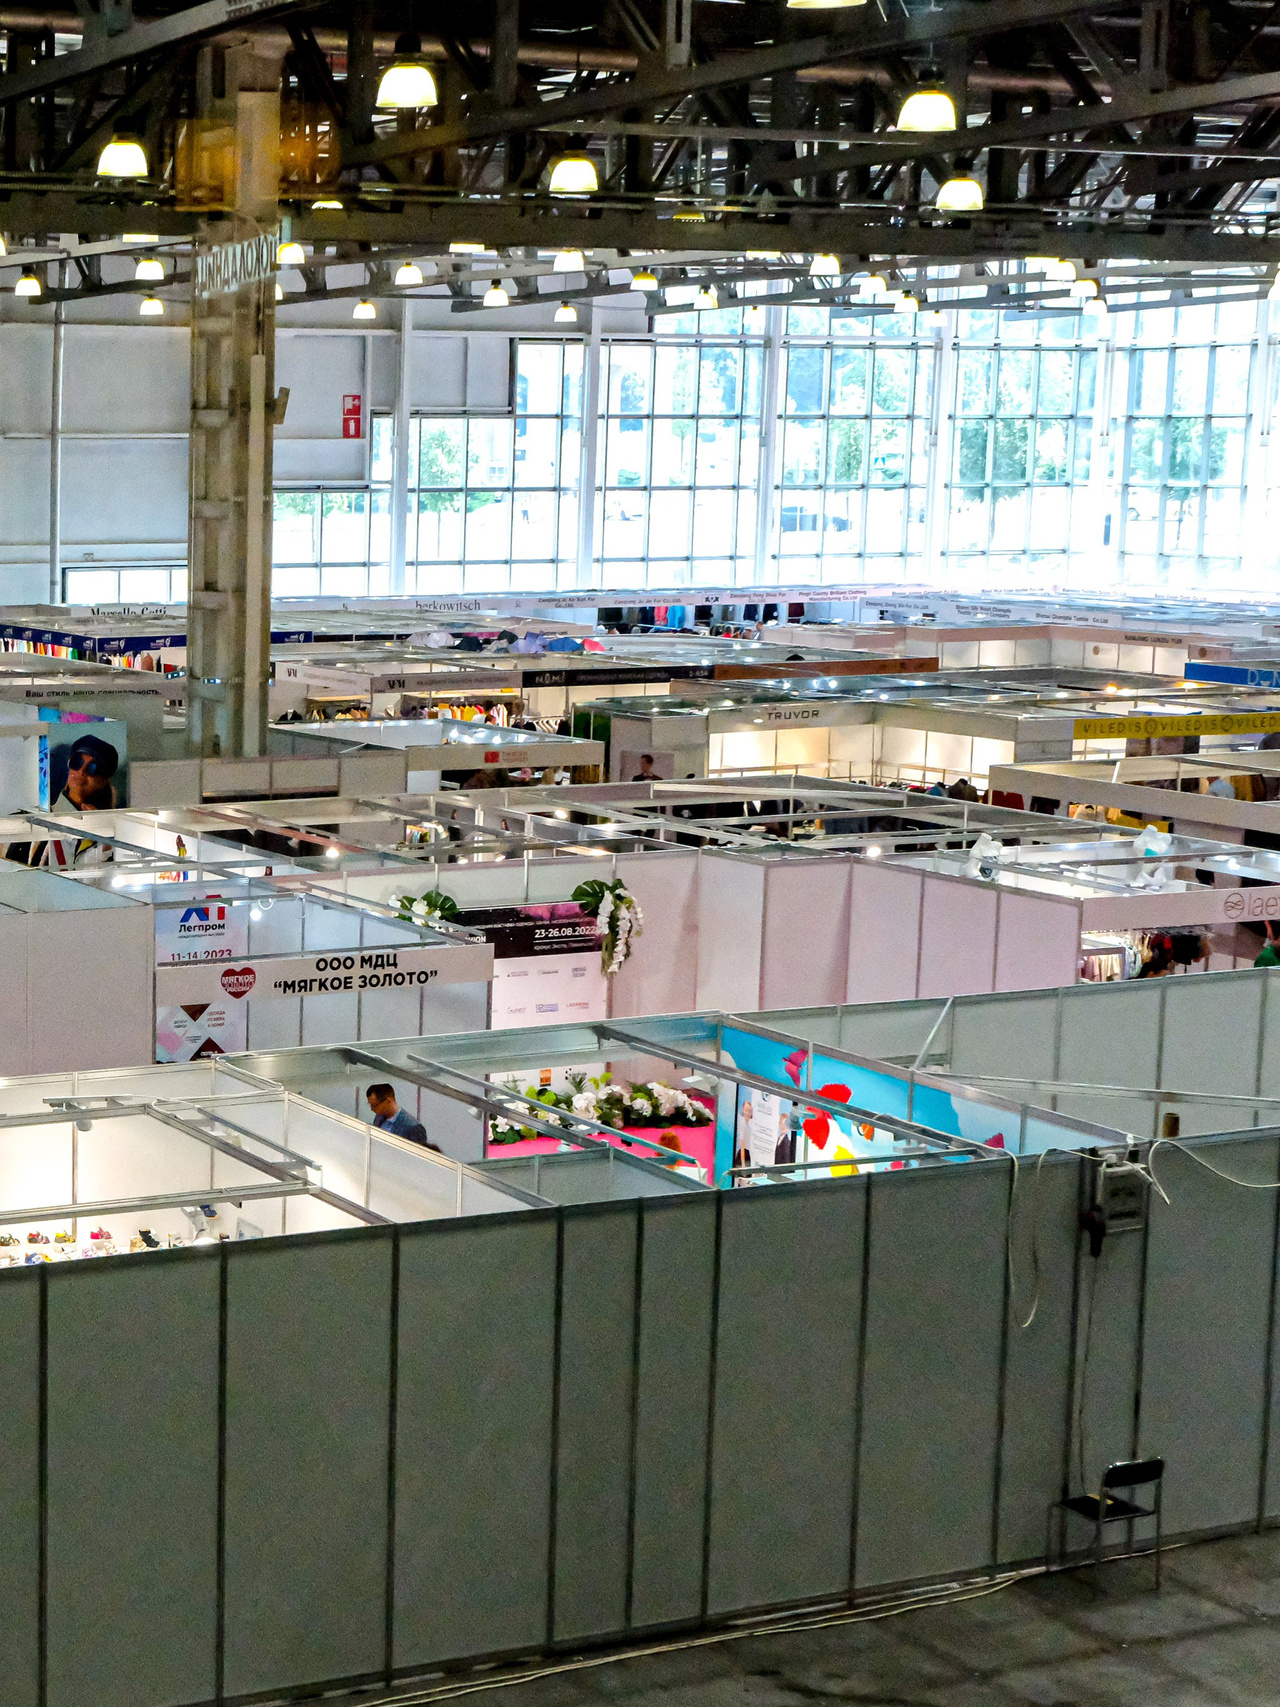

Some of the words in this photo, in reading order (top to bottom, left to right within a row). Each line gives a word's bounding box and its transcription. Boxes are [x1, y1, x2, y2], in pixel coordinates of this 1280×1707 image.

[767, 709, 820, 720] TRUVOR
[179, 922, 226, 933] Легпром
[170, 951, 198, 962] 11-14
[316, 956, 355, 972] ООО
[360, 953, 398, 970] МДЦ
[222, 974, 255, 984] МЯГКОЕ
